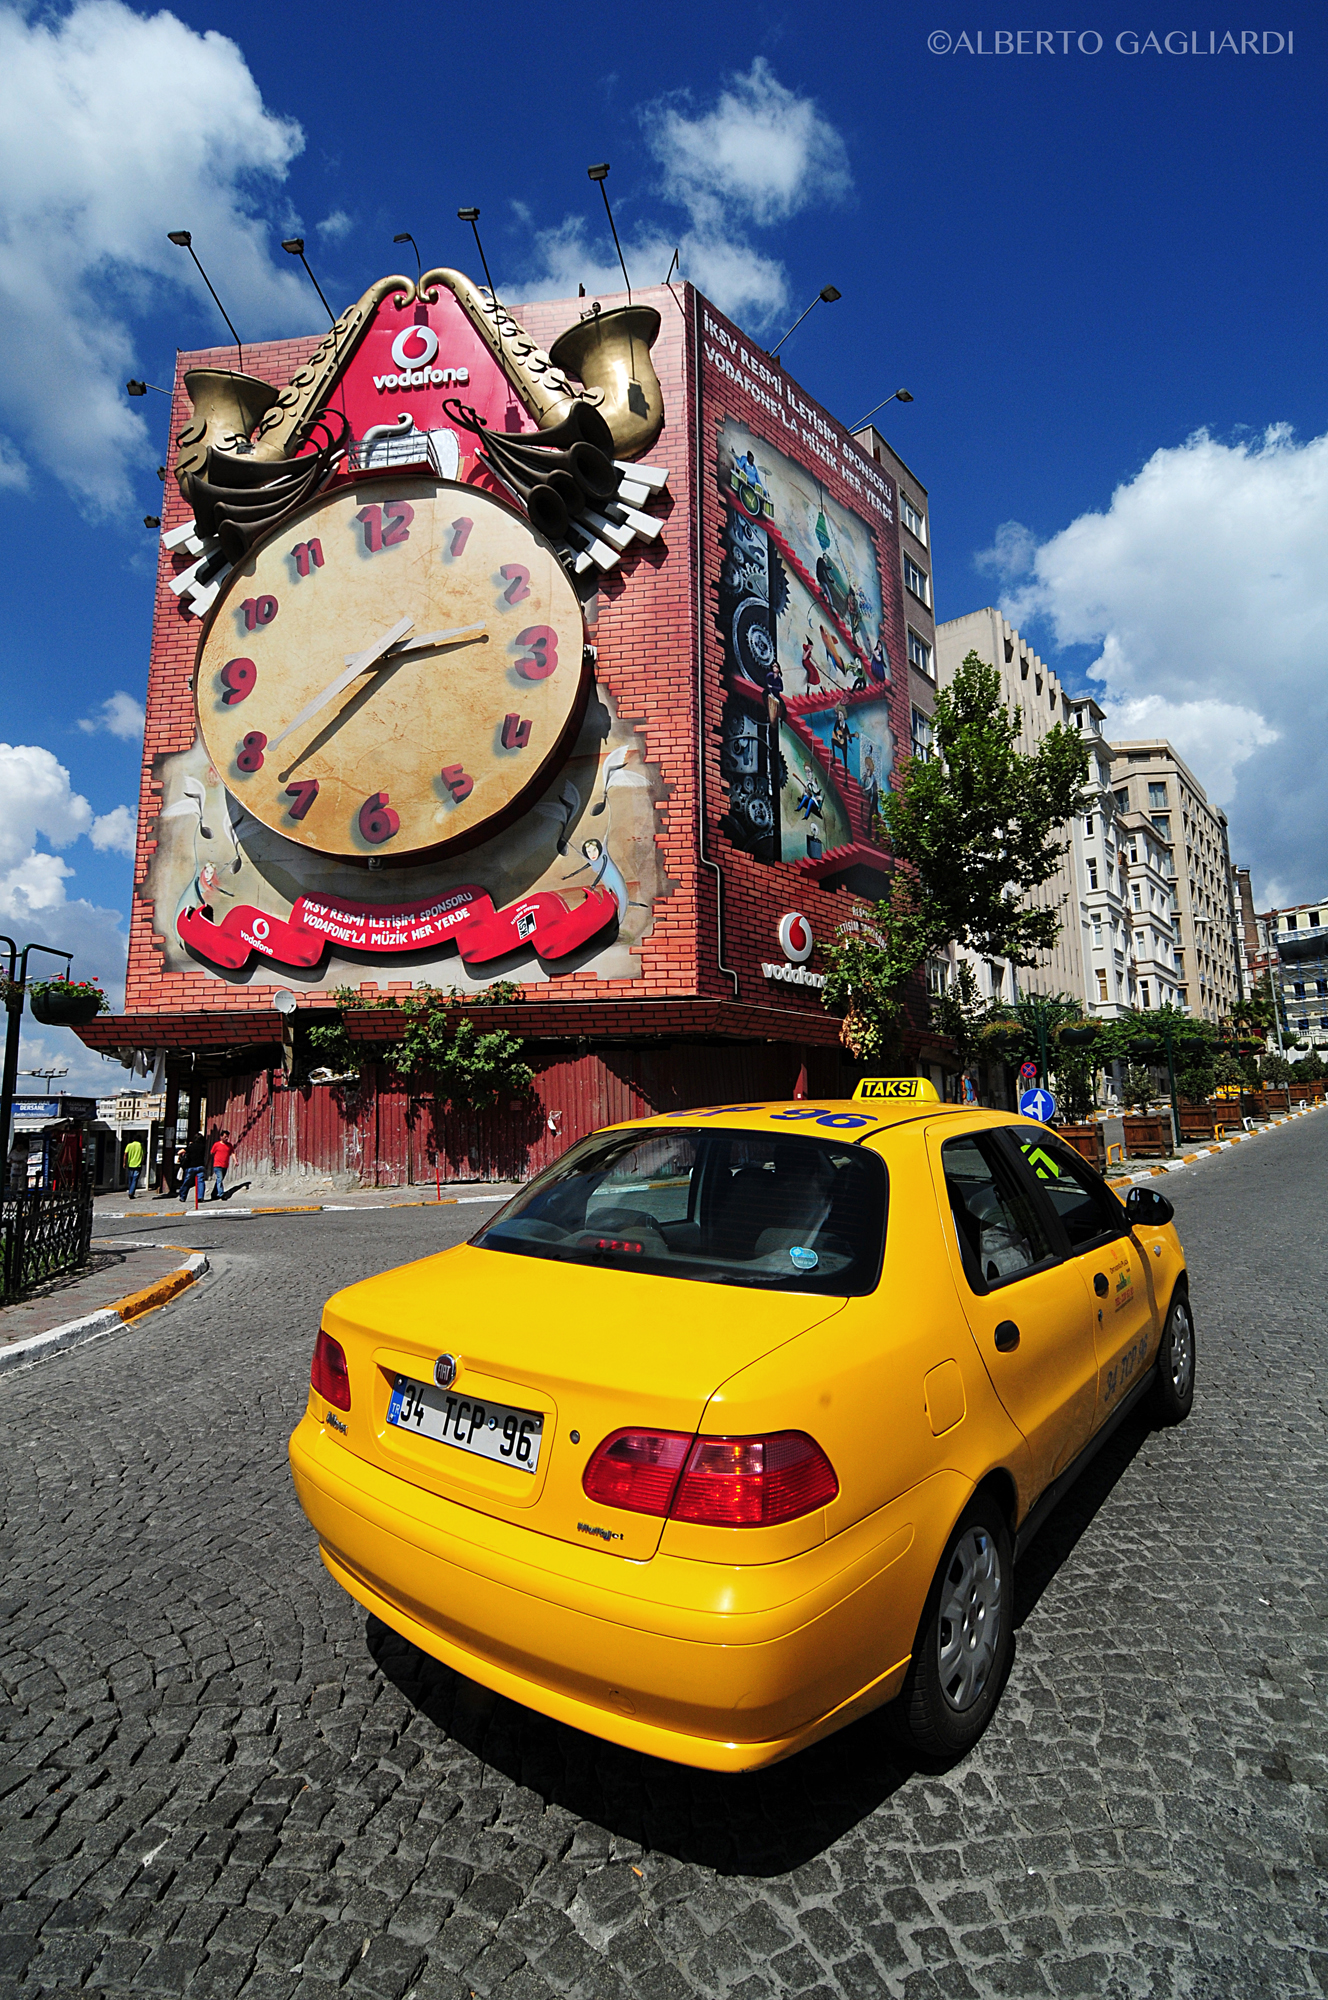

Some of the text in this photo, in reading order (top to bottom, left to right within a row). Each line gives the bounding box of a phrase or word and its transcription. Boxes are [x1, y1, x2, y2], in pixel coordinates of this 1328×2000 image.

[373, 366, 469, 389] vodafone
[842, 442, 892, 502] SPONSORU
[841, 465, 862, 496] HER
[864, 485, 893, 524] YERDE
[356, 500, 415, 553] 12
[450, 516, 474, 557] 1
[290, 537, 325, 577] 11
[500, 563, 530, 605] 2
[240, 594, 279, 631] 10
[514, 624, 558, 680] 3
[221, 657, 257, 705] 9
[501, 712, 533, 750] 4
[236, 731, 267, 773] 8
[285, 779, 320, 820] 7
[441, 763, 474, 804] 5
[359, 792, 400, 844] 6
[302, 898, 329, 916] İKSV
[329, 908, 365, 927] RESMİ
[420, 892, 473, 922] SPONSORU
[303, 907, 470, 945] VODAFONE'LA MÜZİK HER YERDE
[240, 930, 273, 955] vodafone
[769, 1108, 878, 1128] 96
[437, 1363, 452, 1381] FIAT
[392, 1402, 400, 1414] TR
[400, 1385, 535, 1462] 34 TCP 96
